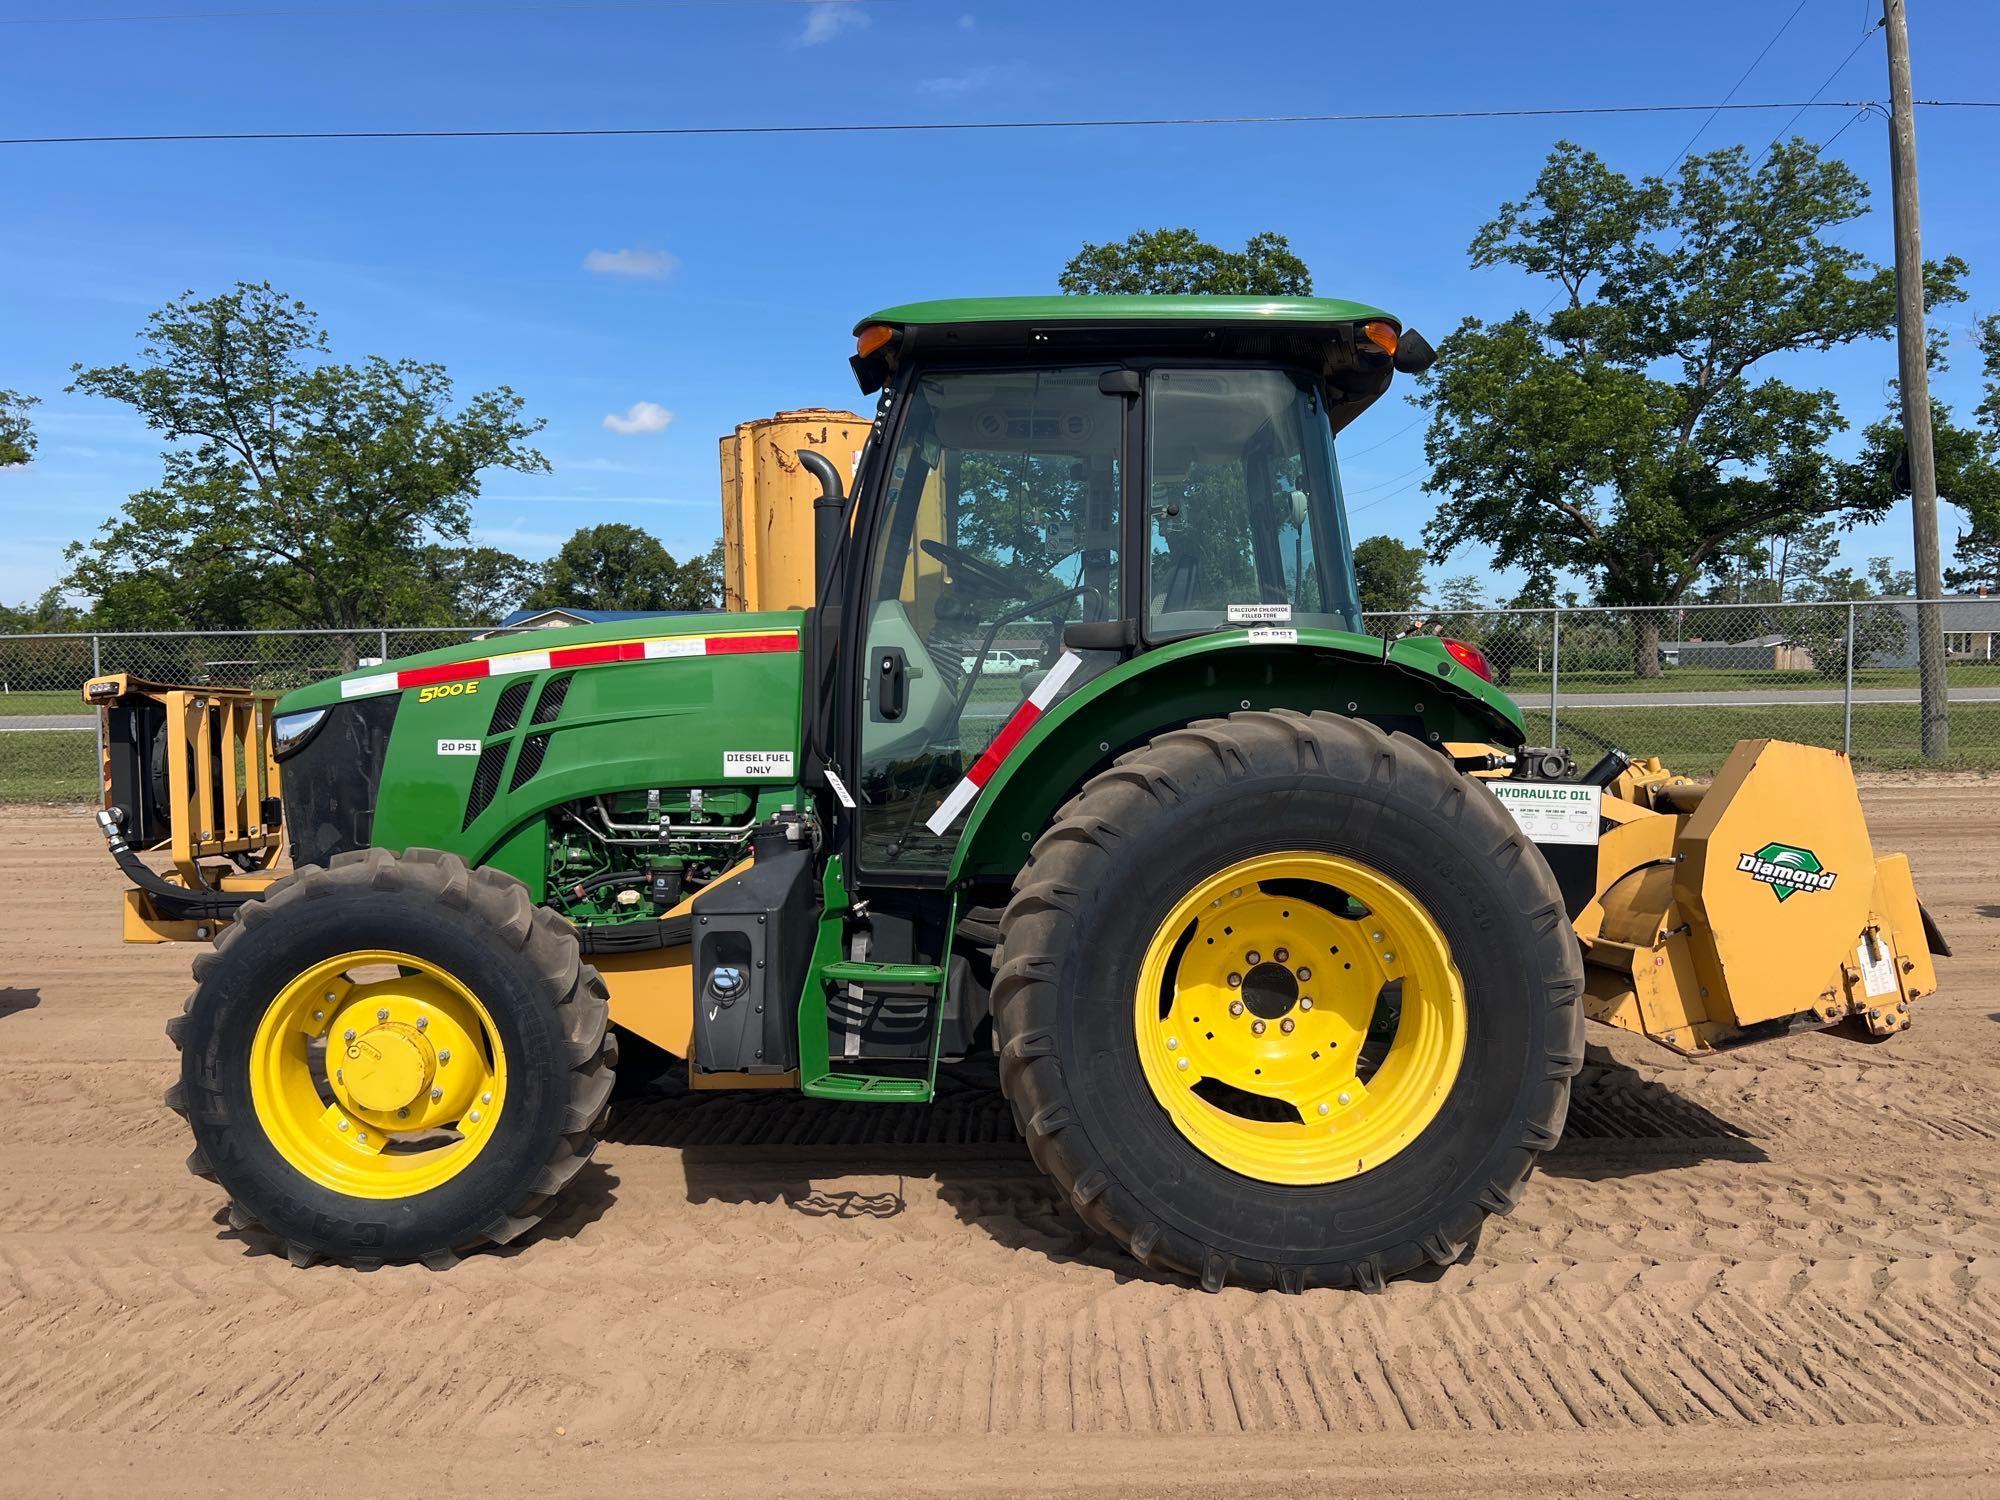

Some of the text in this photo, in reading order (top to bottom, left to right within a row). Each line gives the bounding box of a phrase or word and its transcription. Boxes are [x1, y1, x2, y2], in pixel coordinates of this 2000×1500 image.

[441, 743, 477, 751] 20 PSI
[727, 754, 790, 762] DIESEL FUEL
[746, 766, 771, 774] ONLY
[1495, 788, 1592, 801] HYDRAULIC OIL
[1737, 853, 1837, 889] Diamond
[1753, 873, 1814, 893] MOWERS
